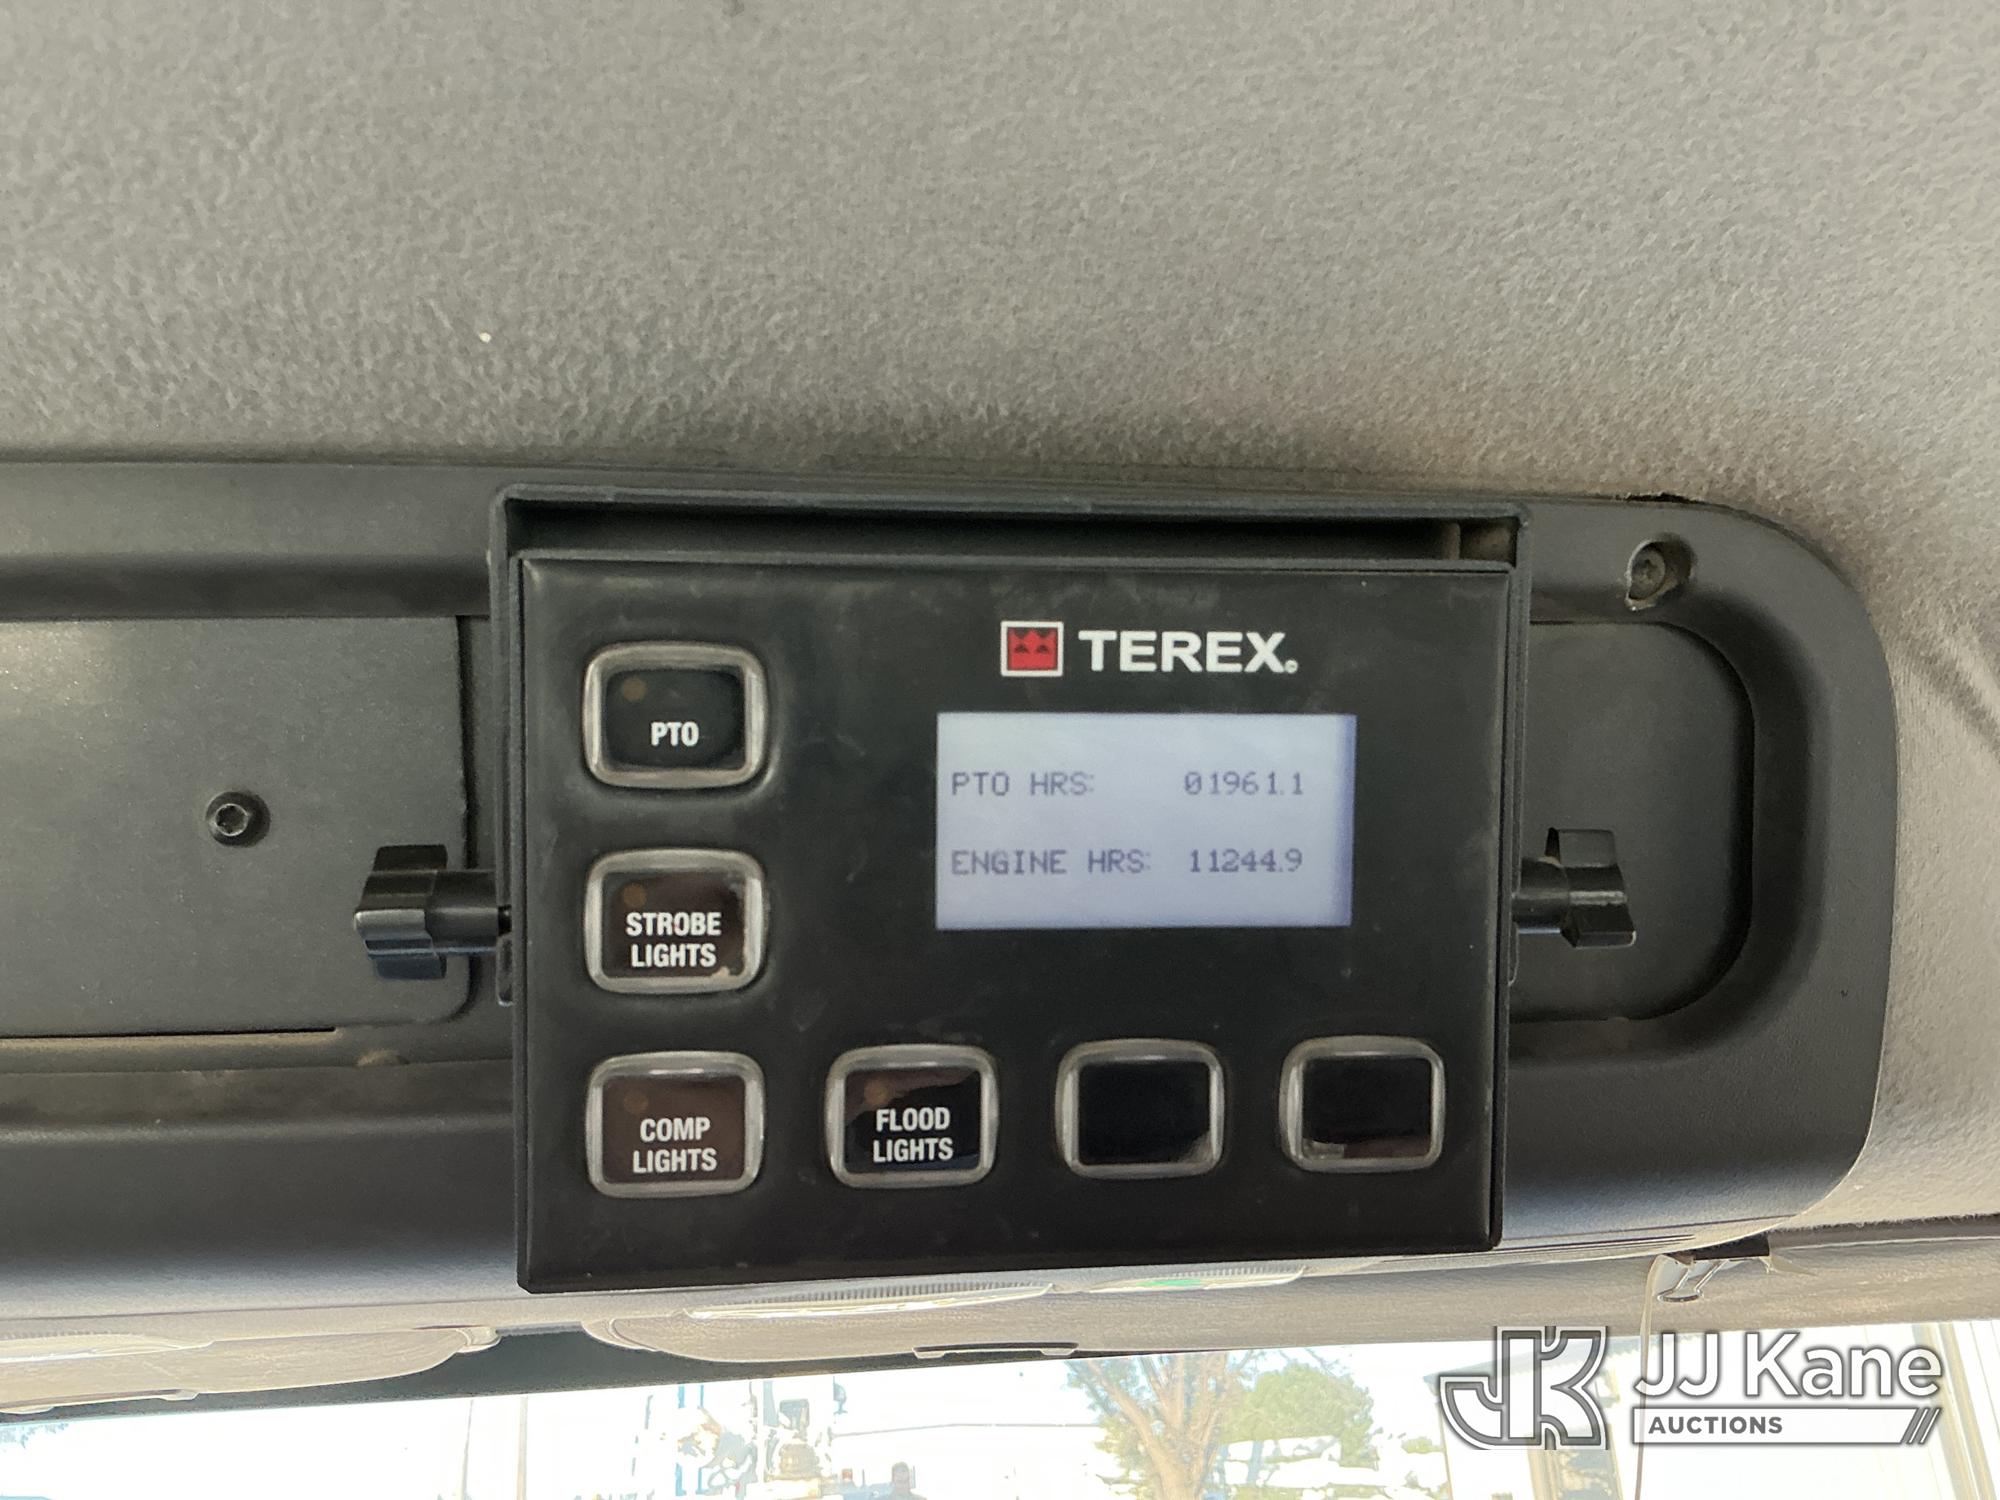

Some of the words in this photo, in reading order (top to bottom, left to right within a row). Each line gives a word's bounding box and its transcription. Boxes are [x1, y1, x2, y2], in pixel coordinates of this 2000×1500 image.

[650, 721, 700, 747] PTO
[951, 771, 1010, 796] PTO
[1029, 771, 1095, 796] HRS:
[1183, 770, 1304, 796] 01961.1
[951, 849, 1067, 875] ENGINE
[1088, 849, 1151, 874] HRS:
[1189, 848, 1303, 873] 11244.9
[625, 911, 722, 936] STROBE
[631, 943, 717, 968] LIGHTS
[639, 1116, 711, 1142] COMP
[876, 1107, 951, 1132] FLOOD
[631, 1148, 718, 1174] LIGHTS
[872, 1137, 954, 1164] LIGHTS
